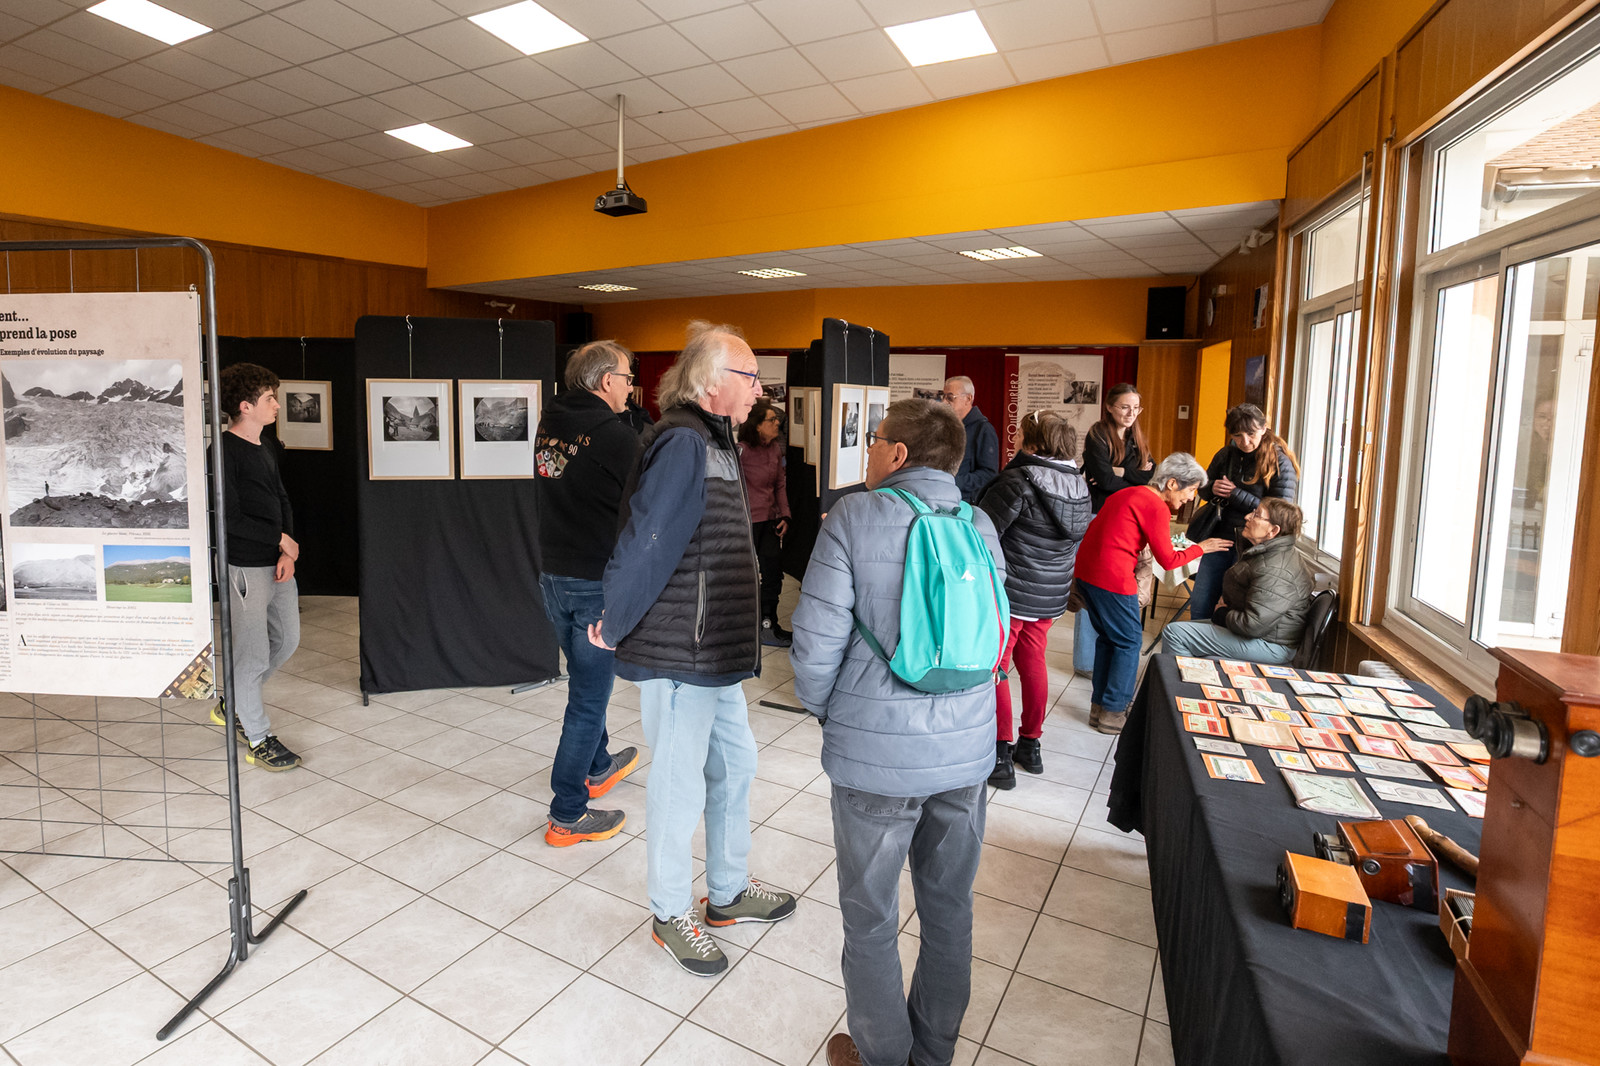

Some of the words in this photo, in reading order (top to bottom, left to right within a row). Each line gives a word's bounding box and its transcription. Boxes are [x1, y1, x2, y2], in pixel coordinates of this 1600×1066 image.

[0, 327, 34, 342] prend
[35, 327, 48, 339] la
[49, 329, 77, 342] pose
[0, 348, 30, 357] Exemples
[68, 348, 77, 356] du
[78, 349, 105, 357] paysage
